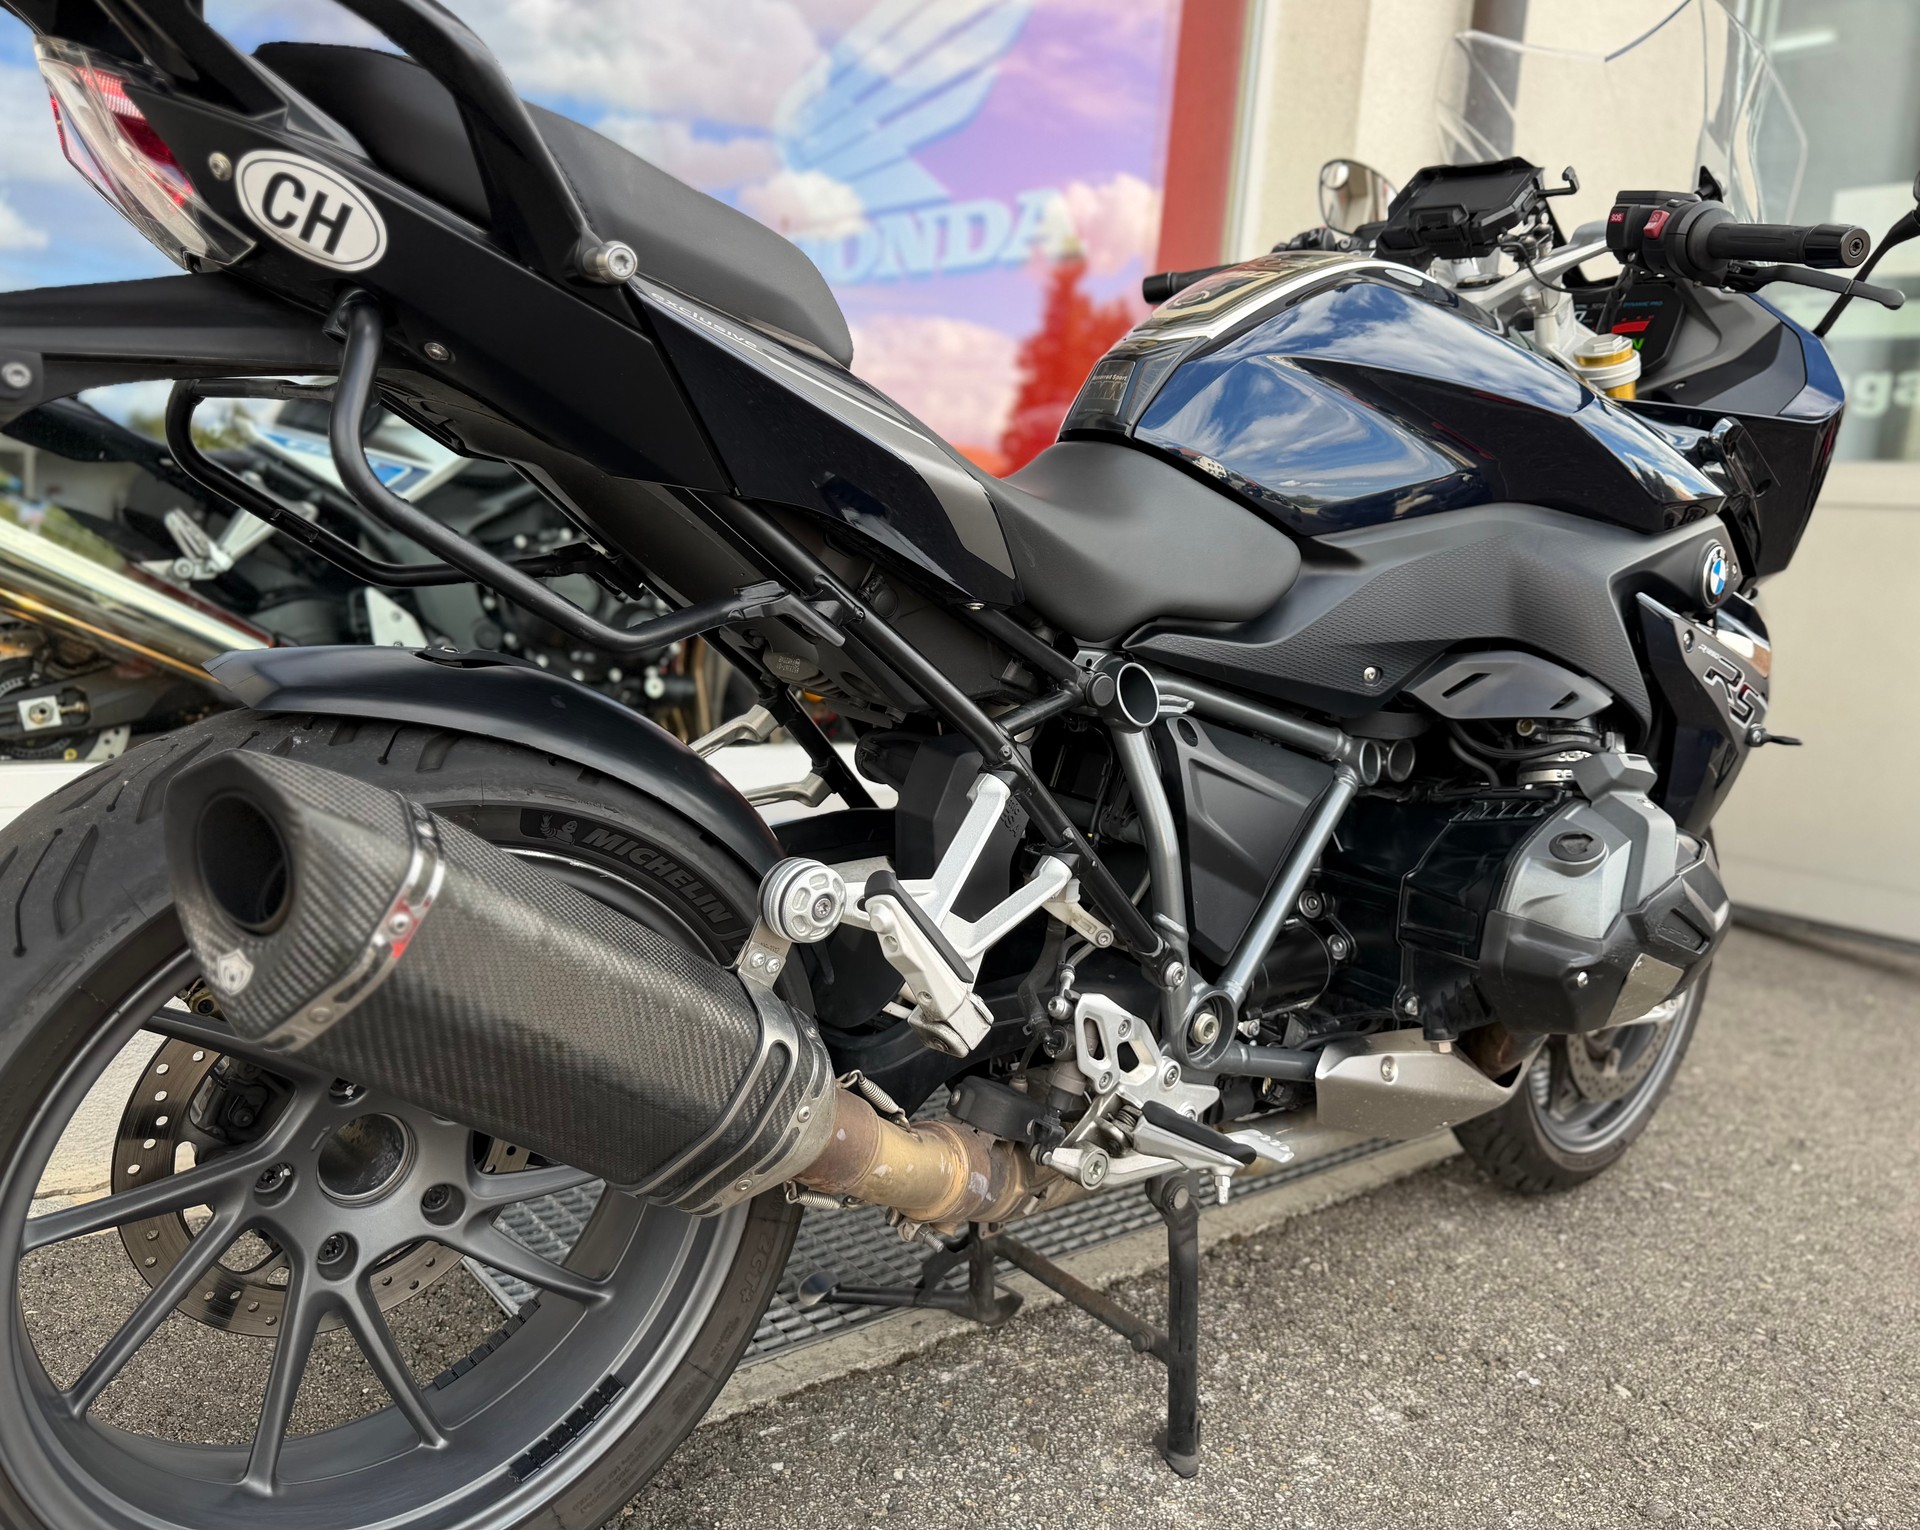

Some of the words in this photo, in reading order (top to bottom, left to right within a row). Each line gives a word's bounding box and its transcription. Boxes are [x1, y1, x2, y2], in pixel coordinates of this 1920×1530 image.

[262, 171, 353, 256] CH
[651, 292, 757, 349] exclusive
[581, 828, 734, 924] MICHELIN
